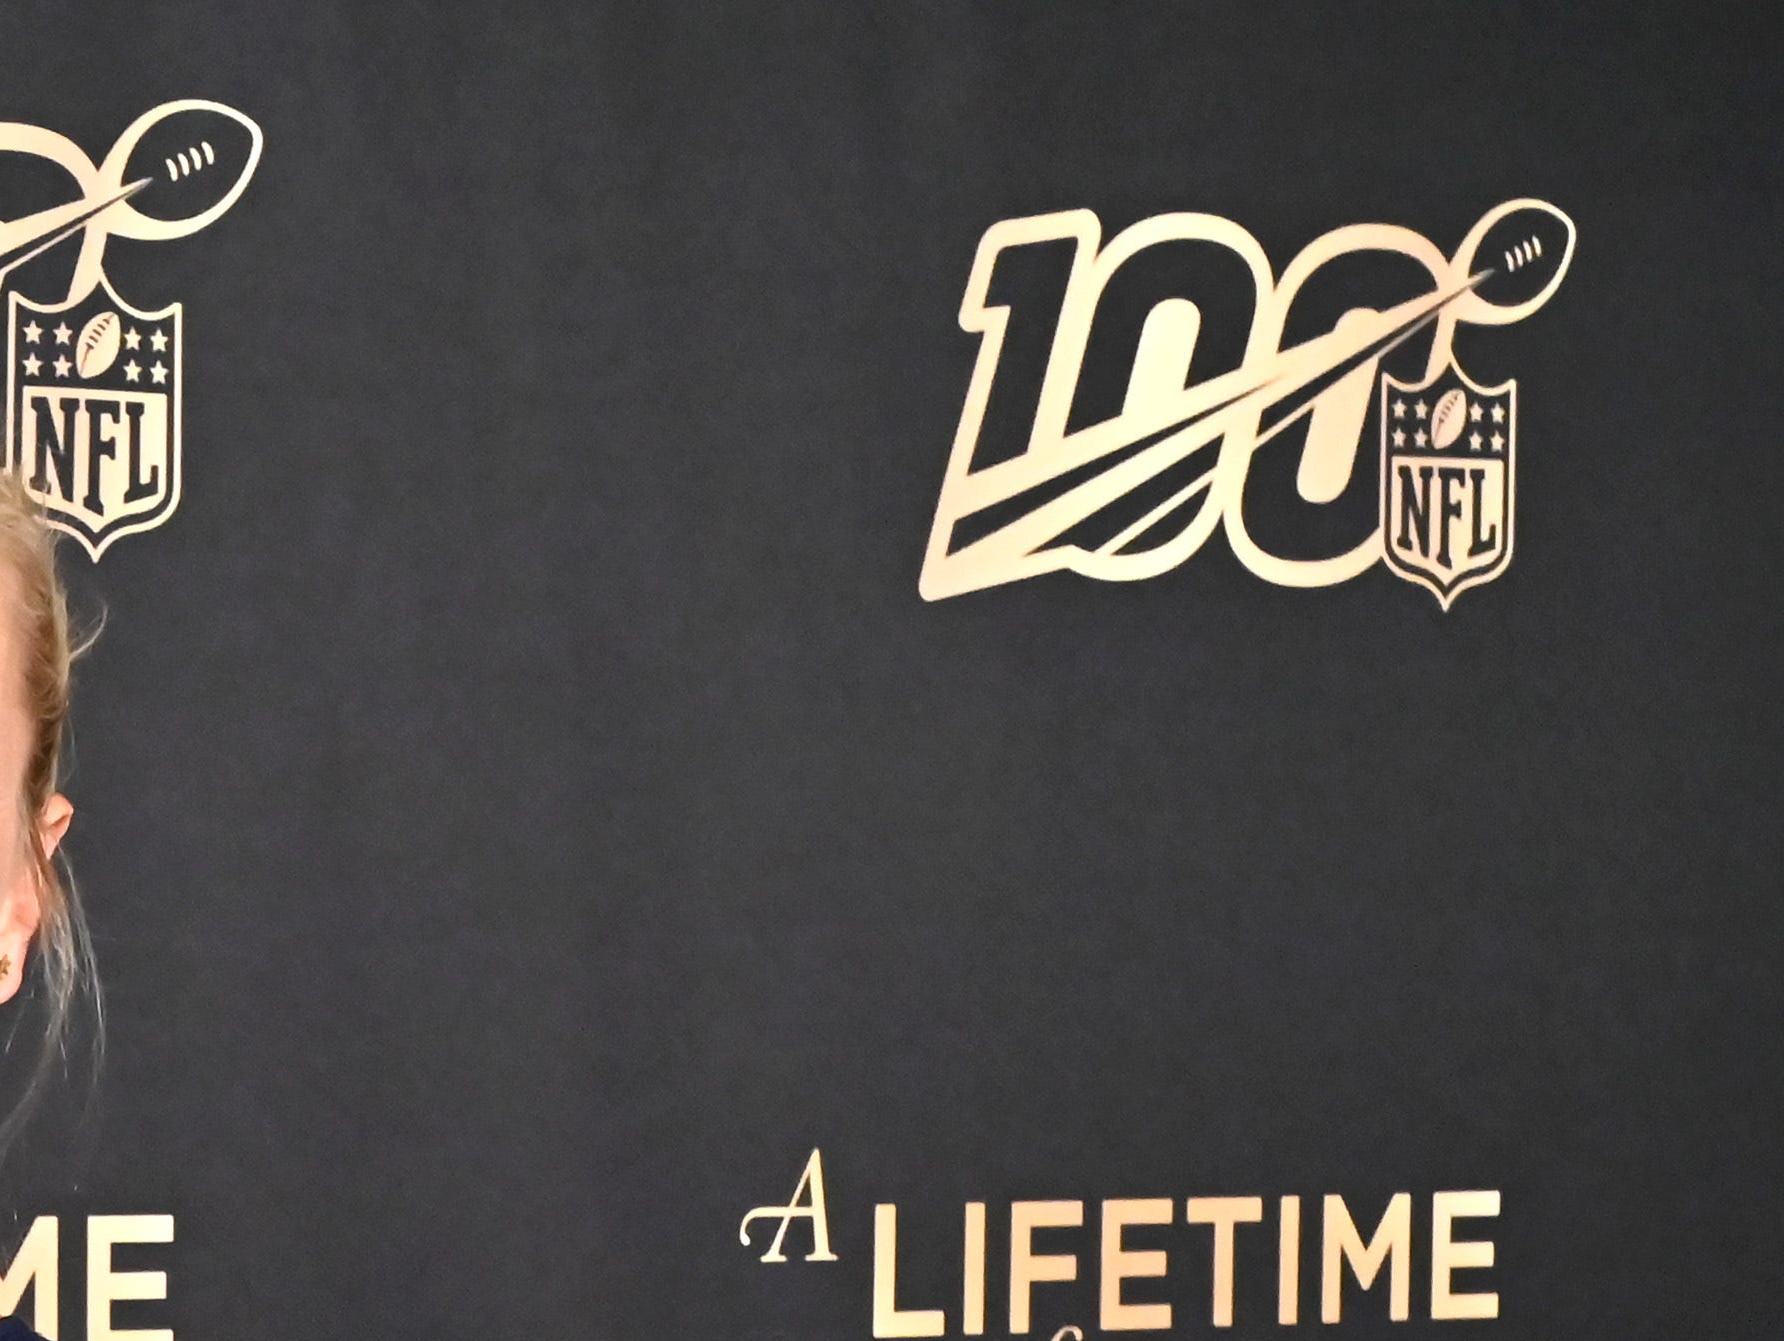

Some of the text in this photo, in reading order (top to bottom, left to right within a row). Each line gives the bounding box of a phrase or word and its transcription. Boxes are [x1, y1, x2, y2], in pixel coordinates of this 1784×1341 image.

[29, 396, 159, 518] NFL
[919, 208, 1451, 602] 100
[1396, 464, 1496, 571] NFL
[739, 1147, 1501, 1338] A LIFETIME
